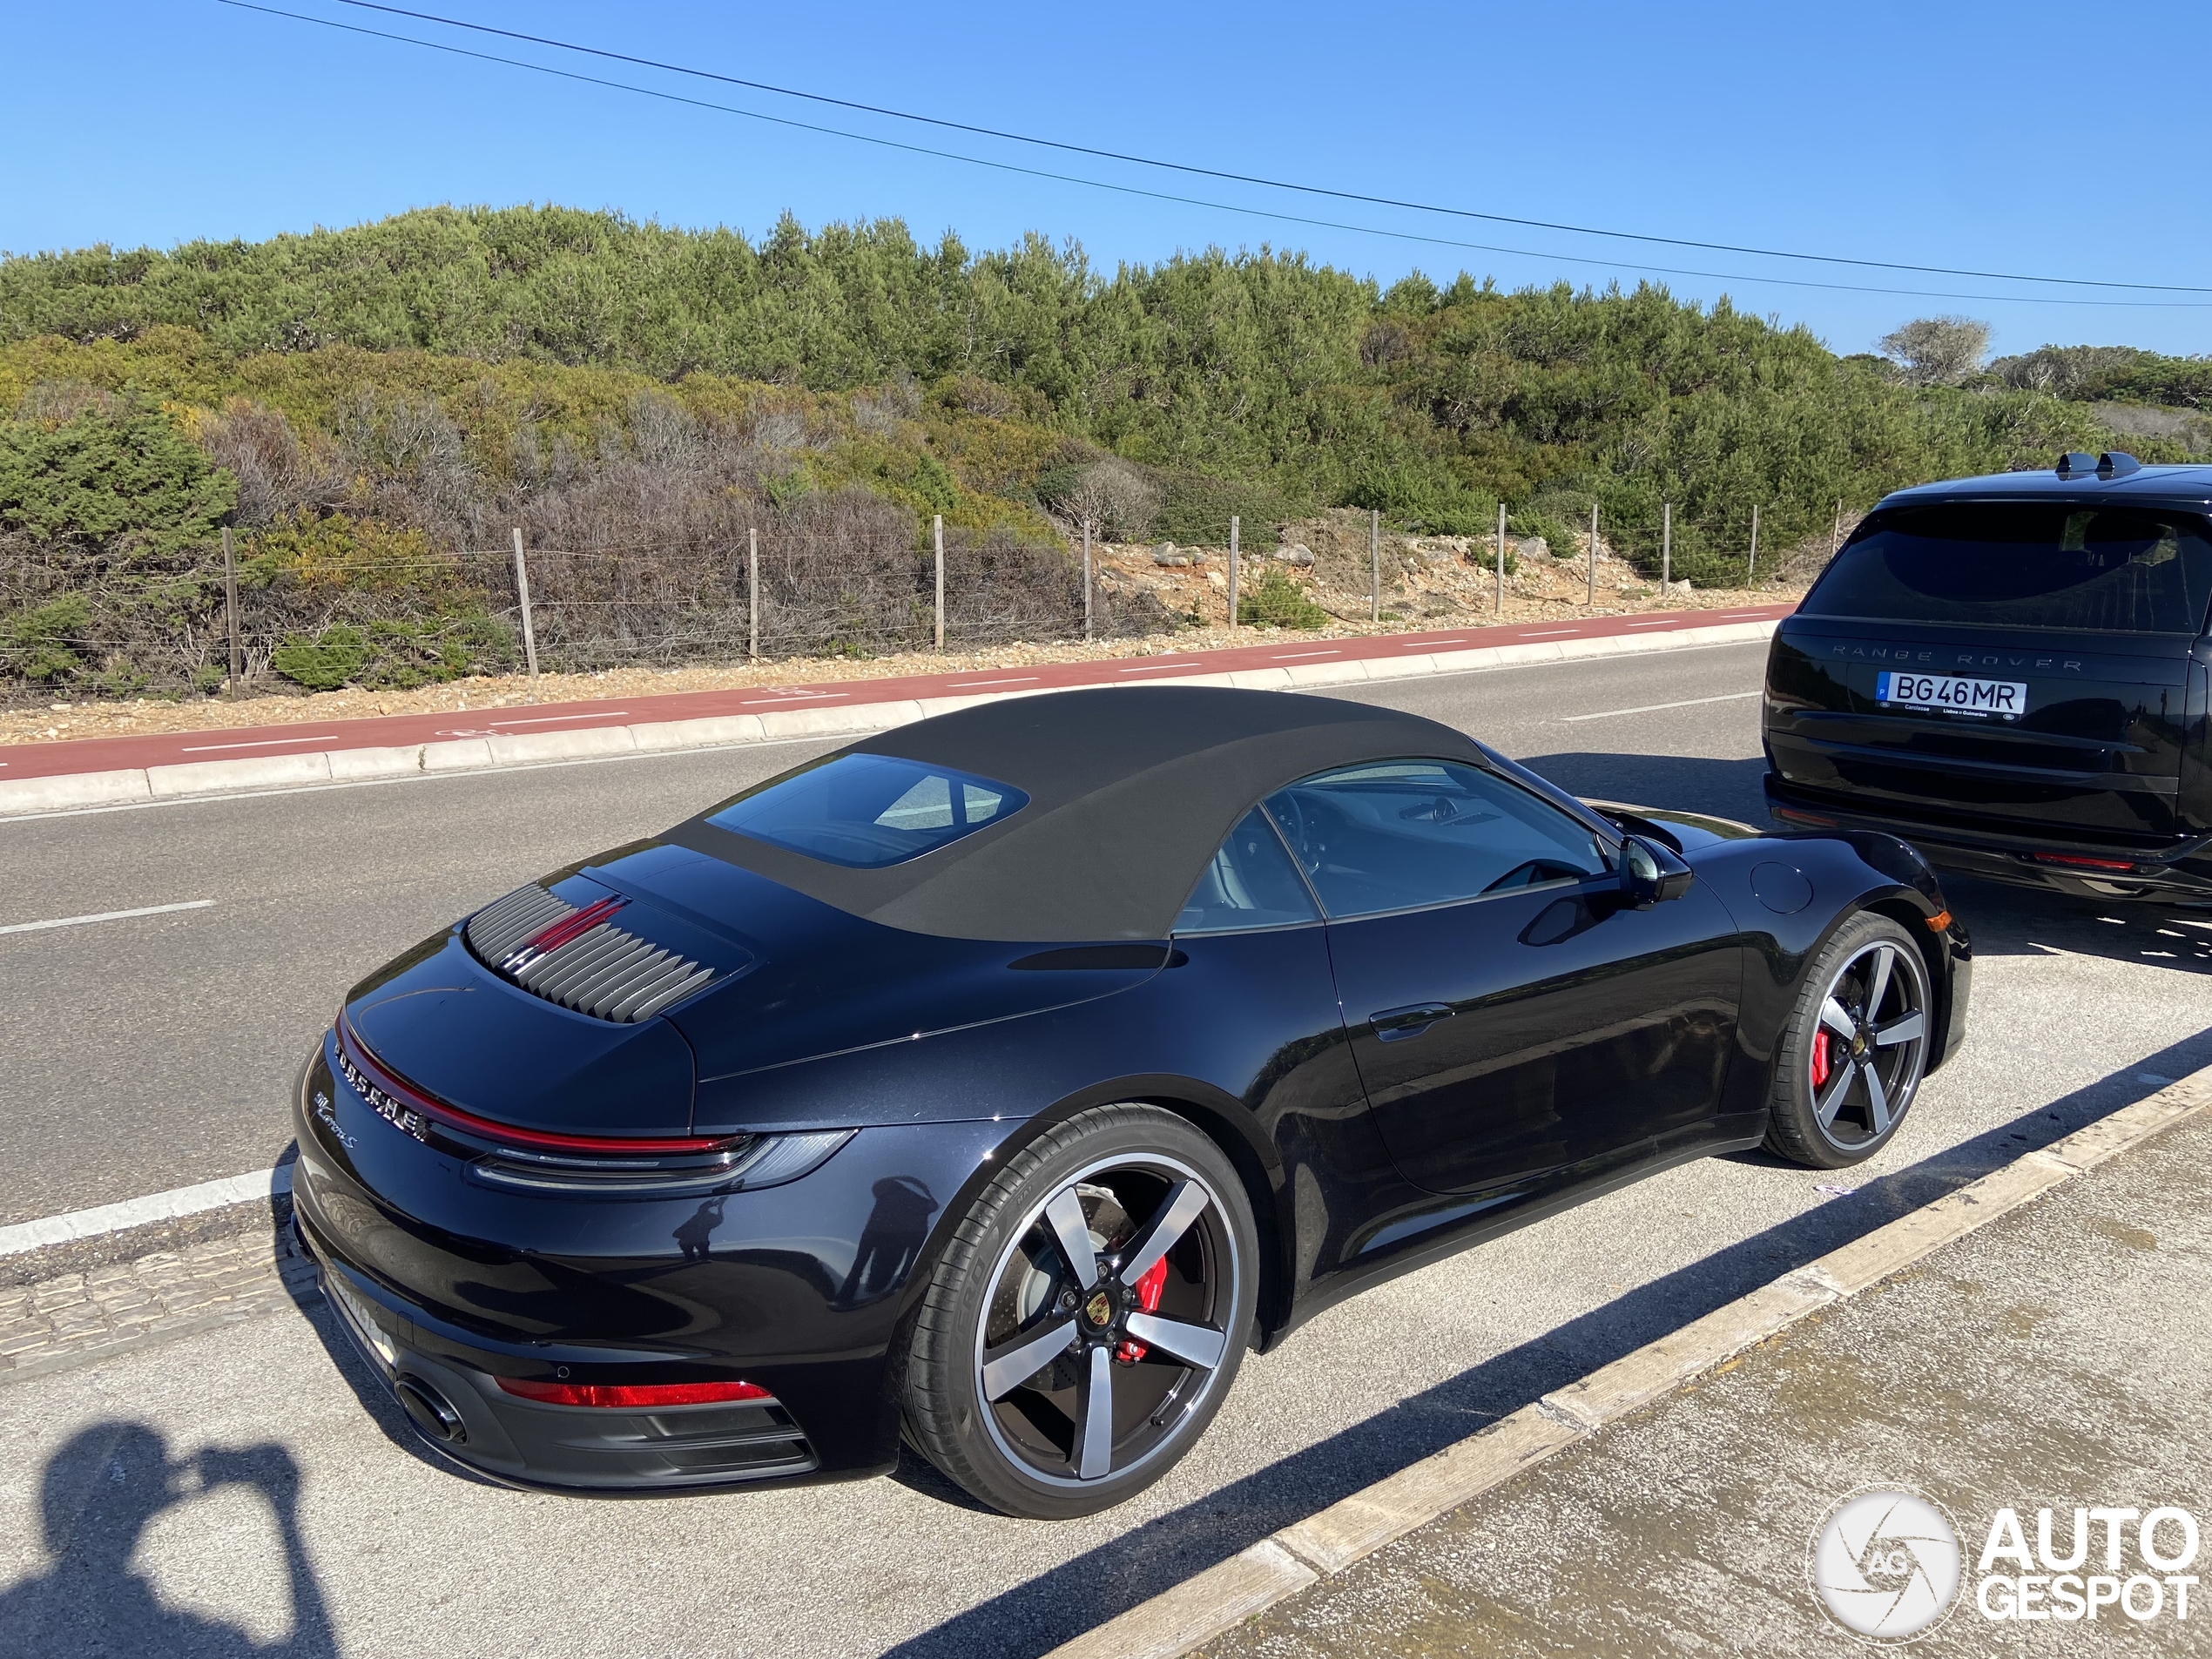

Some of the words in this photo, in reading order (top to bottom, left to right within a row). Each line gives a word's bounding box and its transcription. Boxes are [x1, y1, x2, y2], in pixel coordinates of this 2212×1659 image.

[1832, 644, 1932, 662] RANGE
[1957, 654, 2082, 671] ROVER
[1896, 675, 2016, 710] BG46MR
[334, 1042, 421, 1132] PORSCHE
